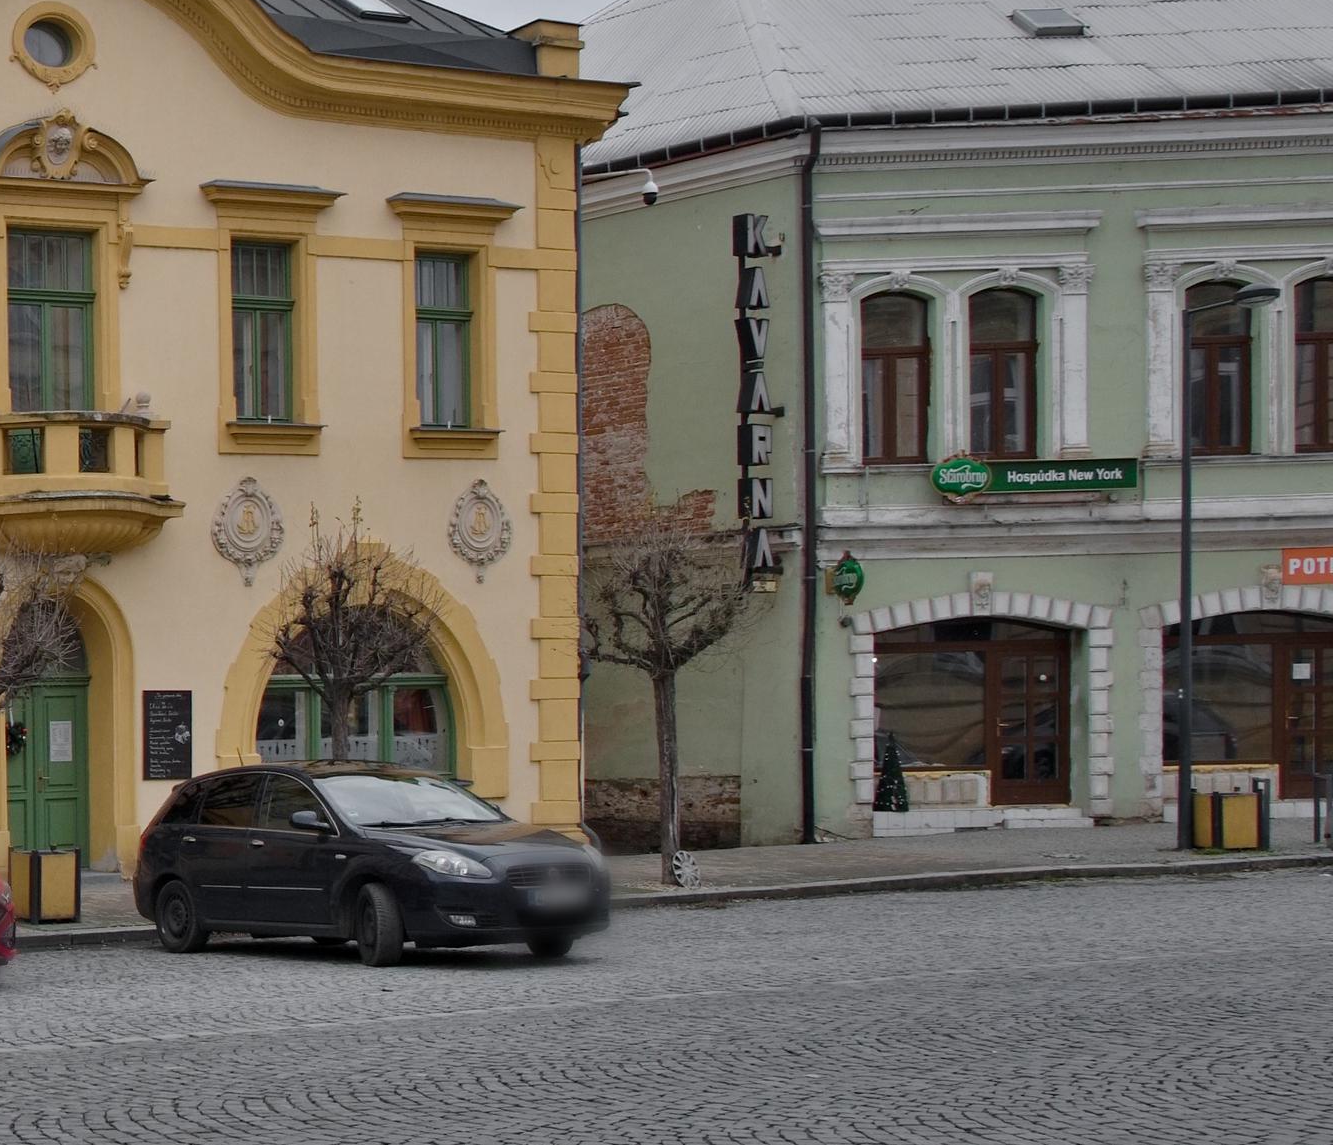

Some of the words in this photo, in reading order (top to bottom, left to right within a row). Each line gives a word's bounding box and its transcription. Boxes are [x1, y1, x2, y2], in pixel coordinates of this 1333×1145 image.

[738, 213, 774, 568] KAVÁRNA
[939, 465, 988, 489] Starobrno
[1068, 468, 1094, 481] New
[1096, 467, 1123, 480] York
[1288, 557, 1333, 575] POT
